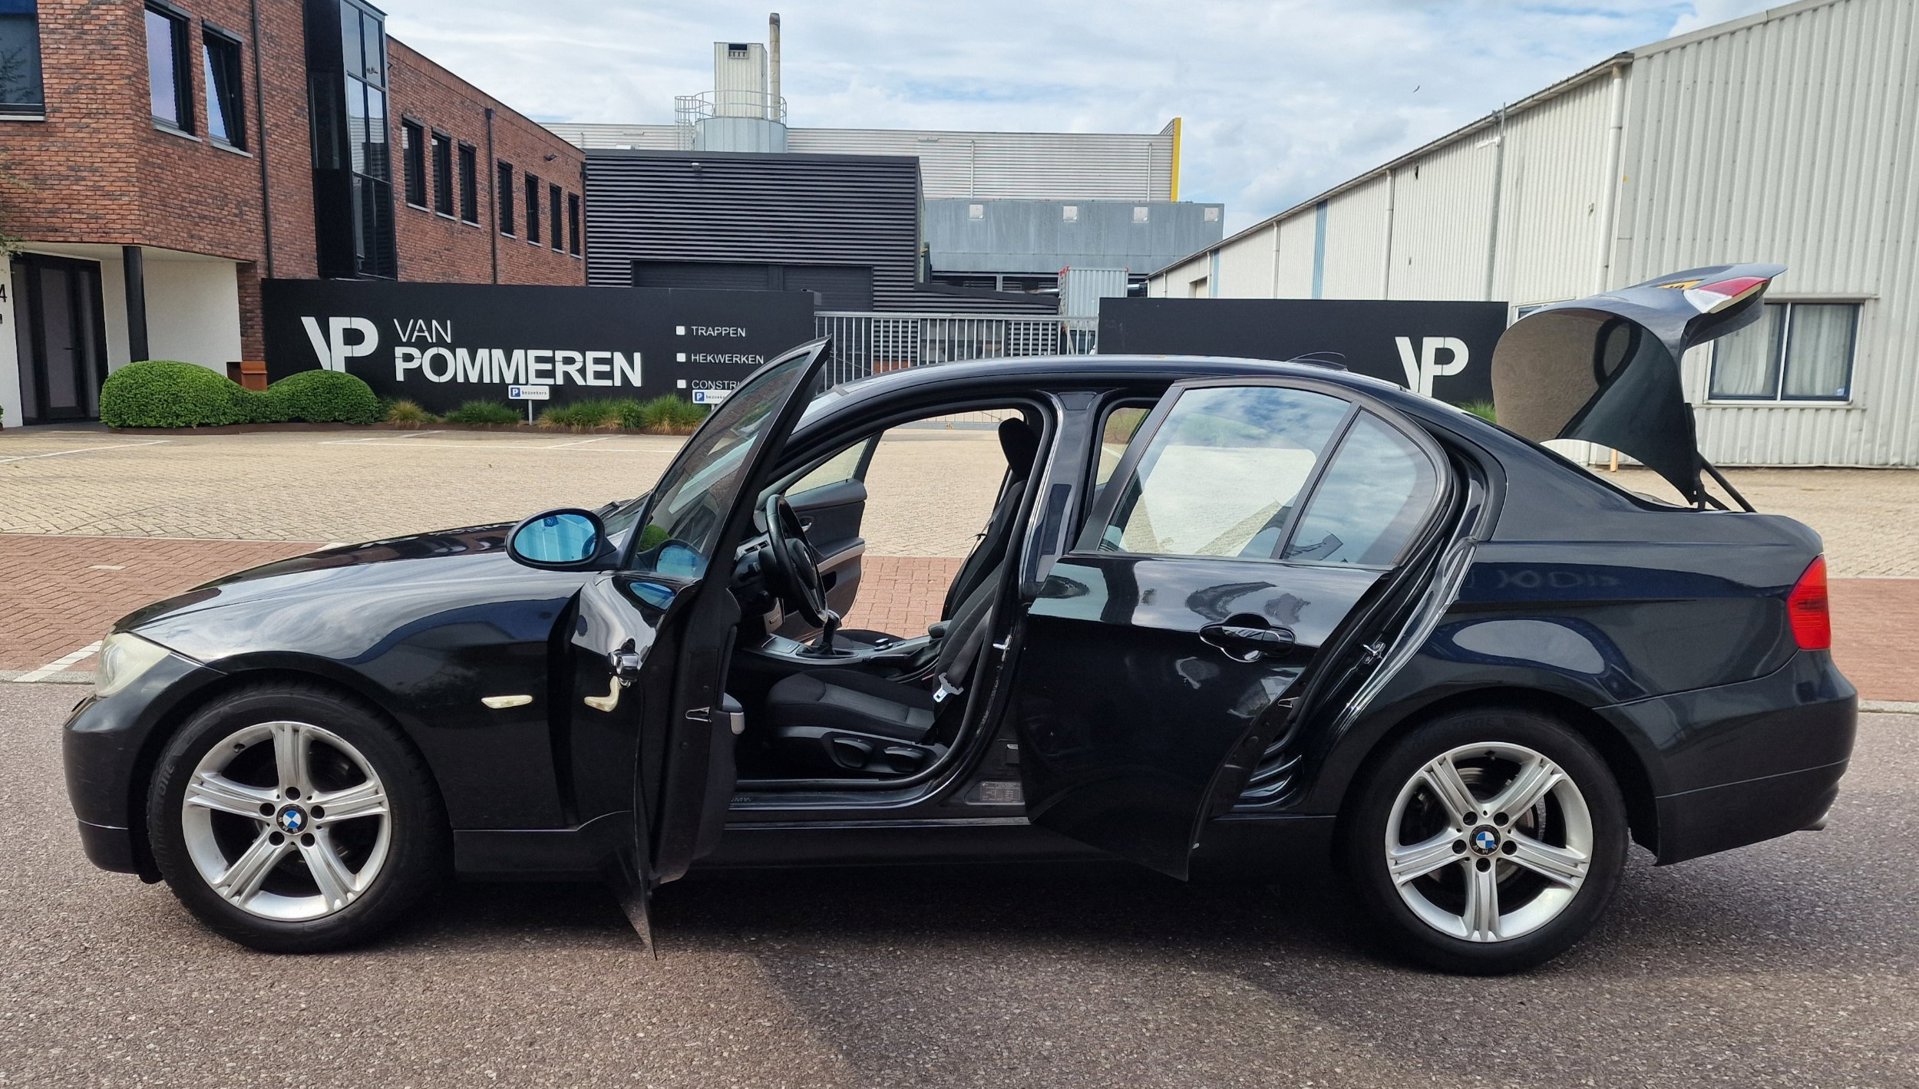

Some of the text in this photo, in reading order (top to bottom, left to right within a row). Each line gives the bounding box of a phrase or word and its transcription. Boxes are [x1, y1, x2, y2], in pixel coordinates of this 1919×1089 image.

[394, 318, 452, 343] VAN
[691, 326, 746, 337] TRAPPEN
[691, 353, 764, 364] HEKWERKEN
[394, 346, 642, 387] POMMEREN
[691, 380, 740, 390] CONSTR
